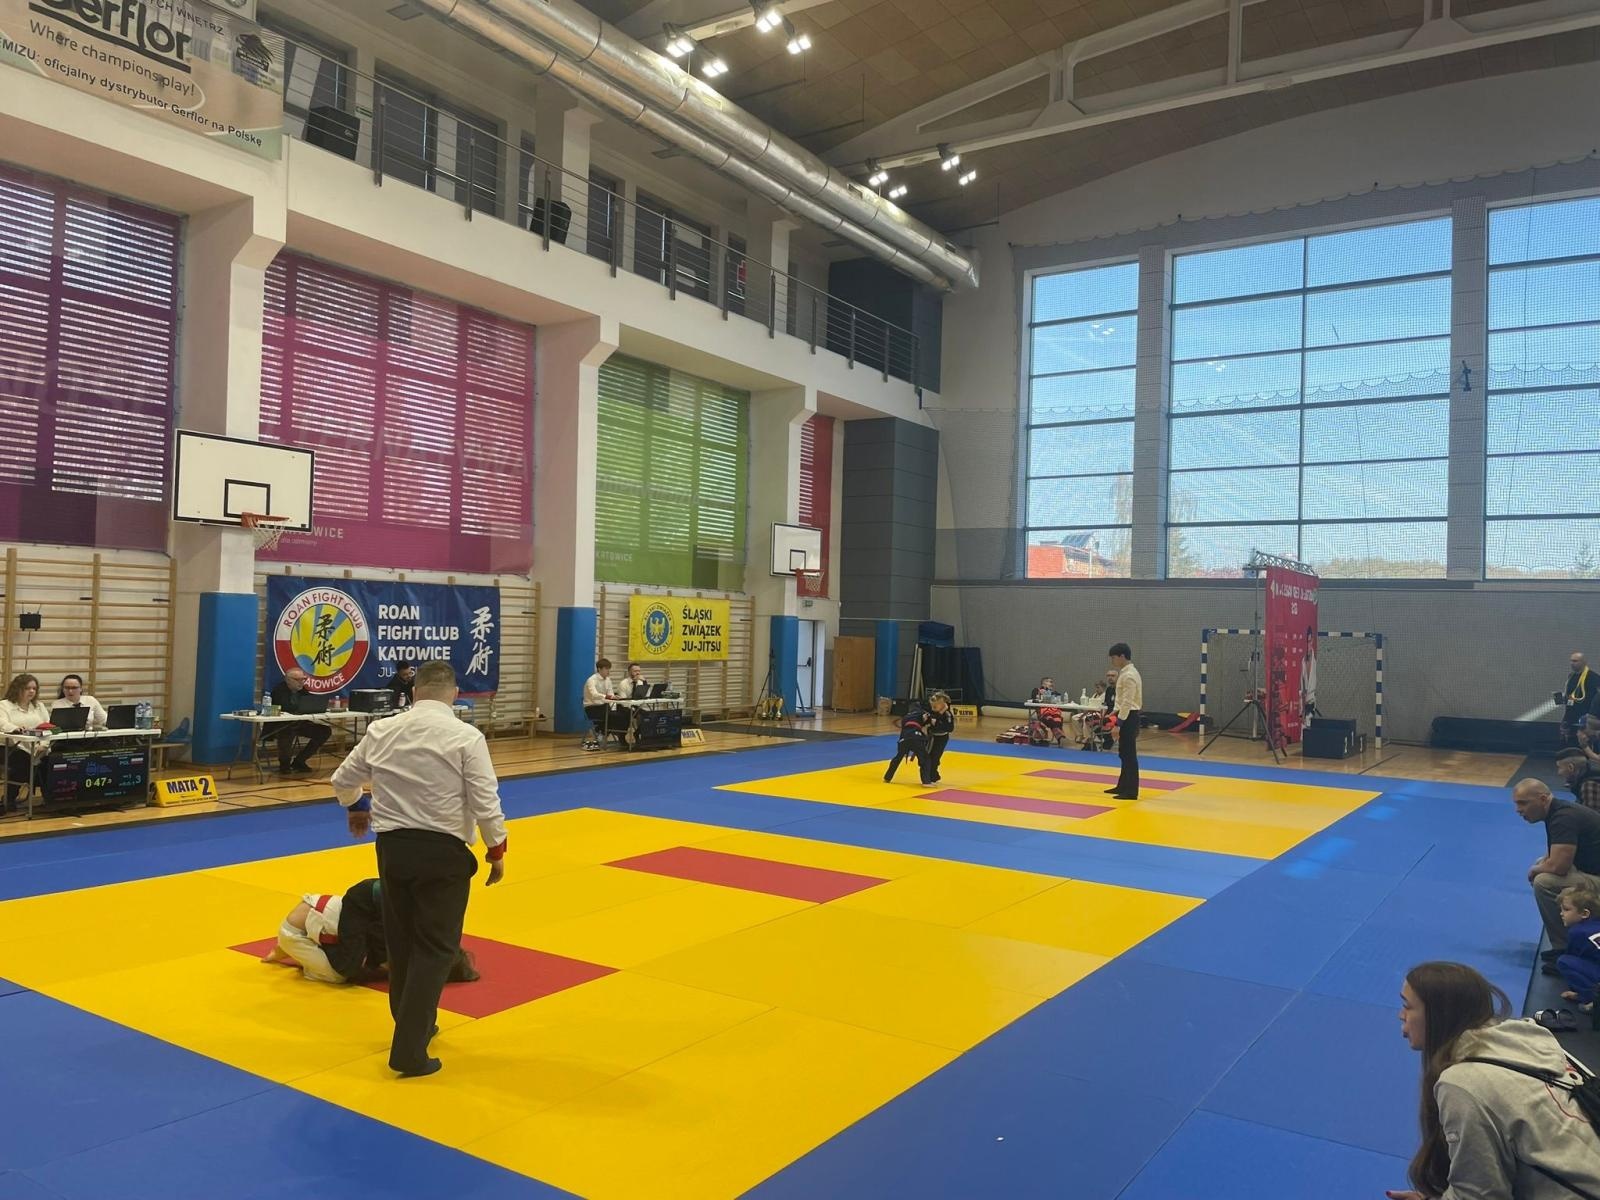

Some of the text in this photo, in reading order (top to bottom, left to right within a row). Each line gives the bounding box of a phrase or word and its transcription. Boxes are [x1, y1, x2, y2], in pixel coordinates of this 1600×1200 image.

[41, 0, 192, 60] erflor
[30, 19, 195, 96] Where champions play!
[44, 57, 96, 85] oficjalny
[100, 77, 168, 109] dystrybutor
[171, 104, 209, 126] Gerflor
[211, 121, 224, 132] na
[283, 592, 363, 629] ROAN FIGHT CLUB
[378, 604, 420, 620] ROAN
[682, 605, 712, 624] ŚLĄSKI
[378, 625, 459, 641] FIGHT CLUB
[682, 625, 721, 640] ZWIĄZEK
[378, 646, 451, 662] KATOWICE
[681, 640, 721, 652] JU-JITSU
[303, 672, 345, 689] ATOWICE
[166, 777, 212, 796] MATA 2
